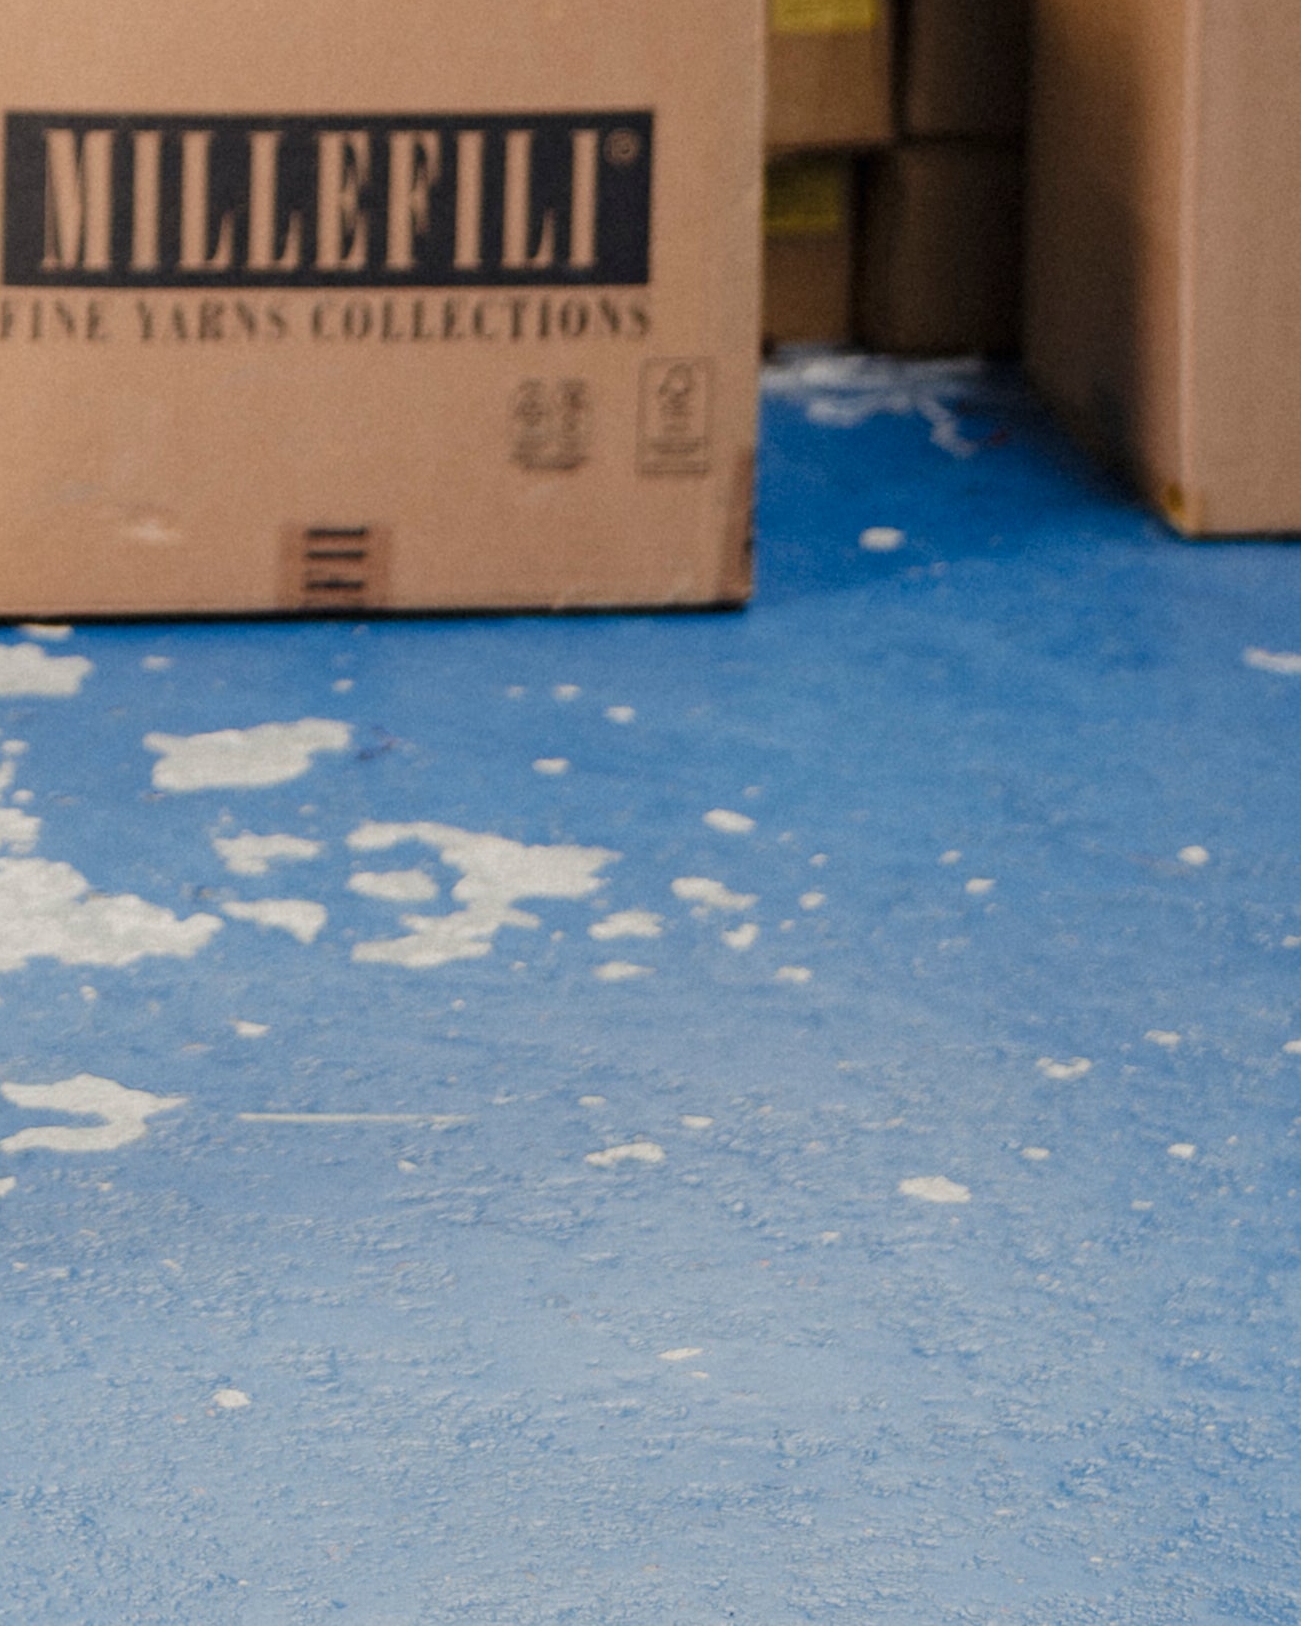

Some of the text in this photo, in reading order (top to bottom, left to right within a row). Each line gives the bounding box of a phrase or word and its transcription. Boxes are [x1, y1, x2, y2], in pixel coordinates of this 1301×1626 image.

[41, 127, 597, 272] MILLEFILI
[134, 297, 292, 343] YARNS
[309, 296, 651, 342] COLLECTIONS
